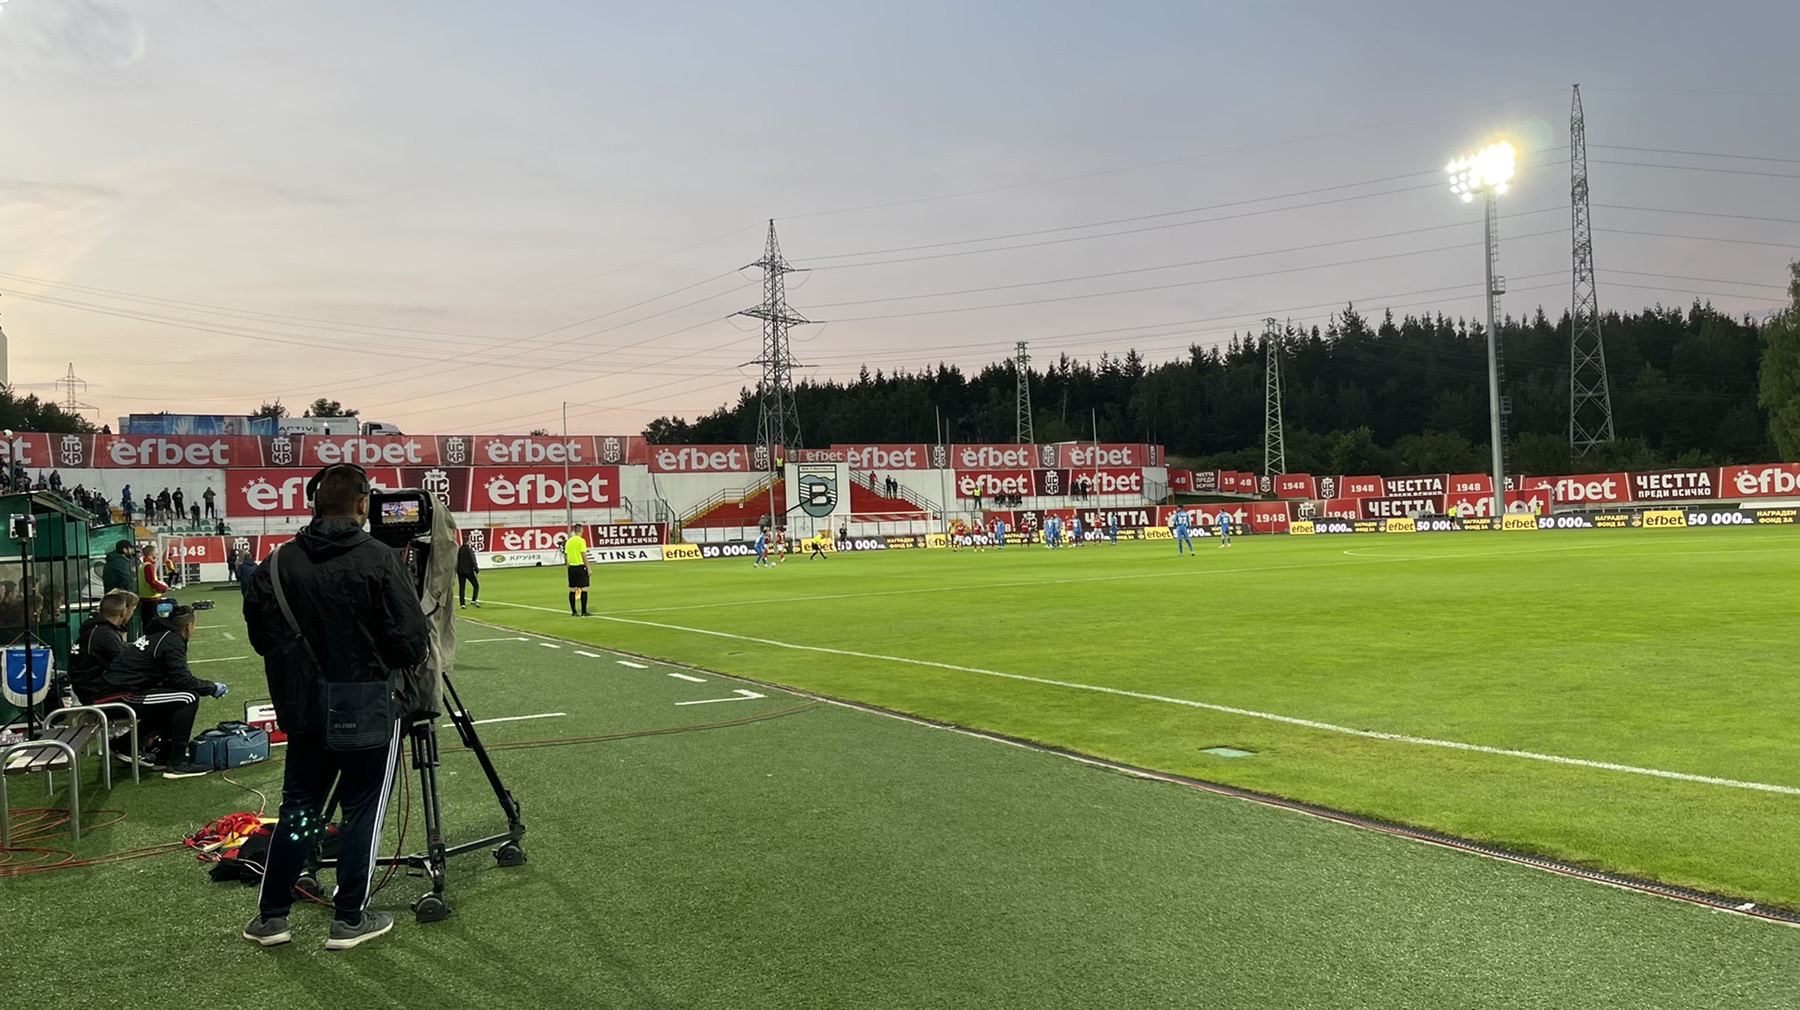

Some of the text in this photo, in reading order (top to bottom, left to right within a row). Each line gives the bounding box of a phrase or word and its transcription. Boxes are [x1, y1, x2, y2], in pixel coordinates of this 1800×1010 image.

[111, 438, 230, 465] efbet
[317, 438, 422, 464] efbet
[488, 438, 582, 463] efbet
[807, 450, 842, 461] efbet
[1071, 446, 1132, 466] efbet
[658, 447, 741, 471] efbet
[848, 446, 916, 468] efbet
[962, 446, 1028, 467] efbet
[960, 474, 1028, 495] efbet
[1224, 477, 1235, 485] 19
[1282, 482, 1305, 490] 1948
[1387, 478, 1442, 492] ЧЕСТТА
[1636, 472, 1711, 490] ЧЕСТТА
[488, 473, 609, 505] efbet
[1350, 484, 1375, 492] 1948
[1456, 483, 1481, 492] 1948
[1638, 487, 1711, 498] ПРЕДИ ВСИЧКО
[1256, 513, 1286, 523] 1948
[1538, 518, 1555, 528] 50
[1646, 516, 1684, 526] efbet
[1687, 513, 1708, 526] 50
[1291, 524, 1314, 533] efbet
[1315, 524, 1328, 533] 50
[1388, 522, 1414, 531] efbet
[1416, 521, 1430, 531] 50
[1505, 519, 1535, 529] efbet
[598, 525, 658, 538] ЧЕСТТА
[1147, 530, 1170, 539] efbet
[599, 538, 625, 546] ПРЕДИ
[598, 550, 648, 561] TINSA
[666, 548, 700, 559] efbet
[703, 546, 720, 557] 50
